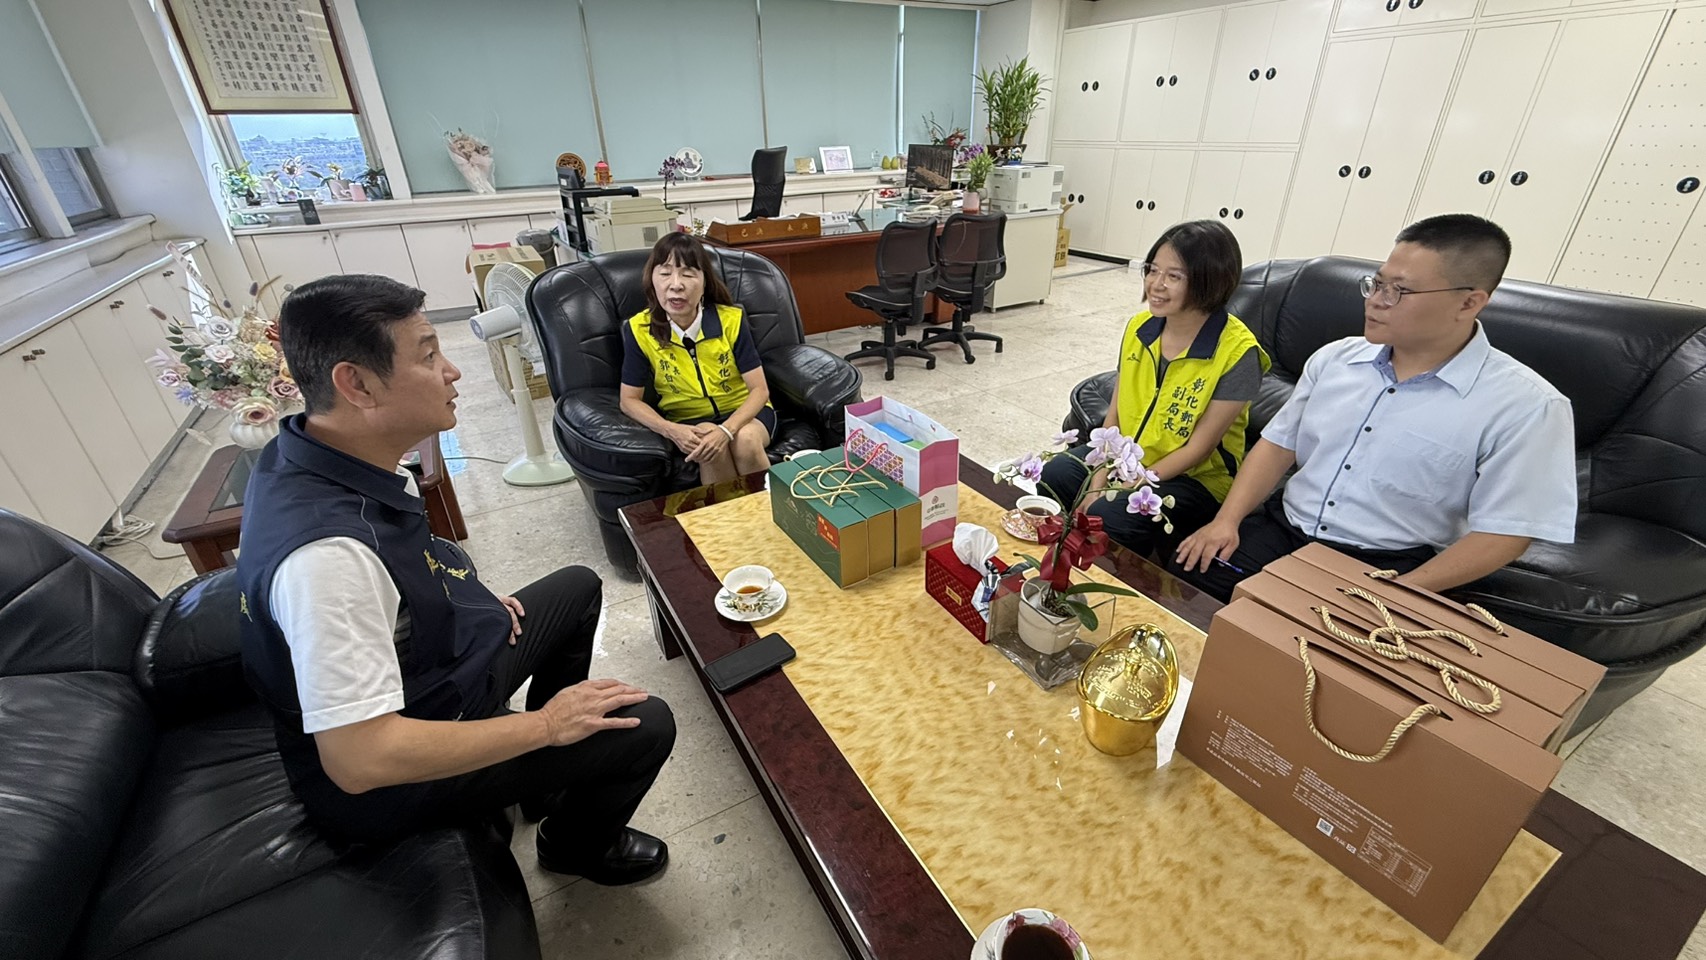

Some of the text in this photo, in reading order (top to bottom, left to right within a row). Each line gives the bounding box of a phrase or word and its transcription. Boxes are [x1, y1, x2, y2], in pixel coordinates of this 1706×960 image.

[1163, 386, 1187, 431] 副局長
[1175, 377, 1206, 438] 彰化郵局
